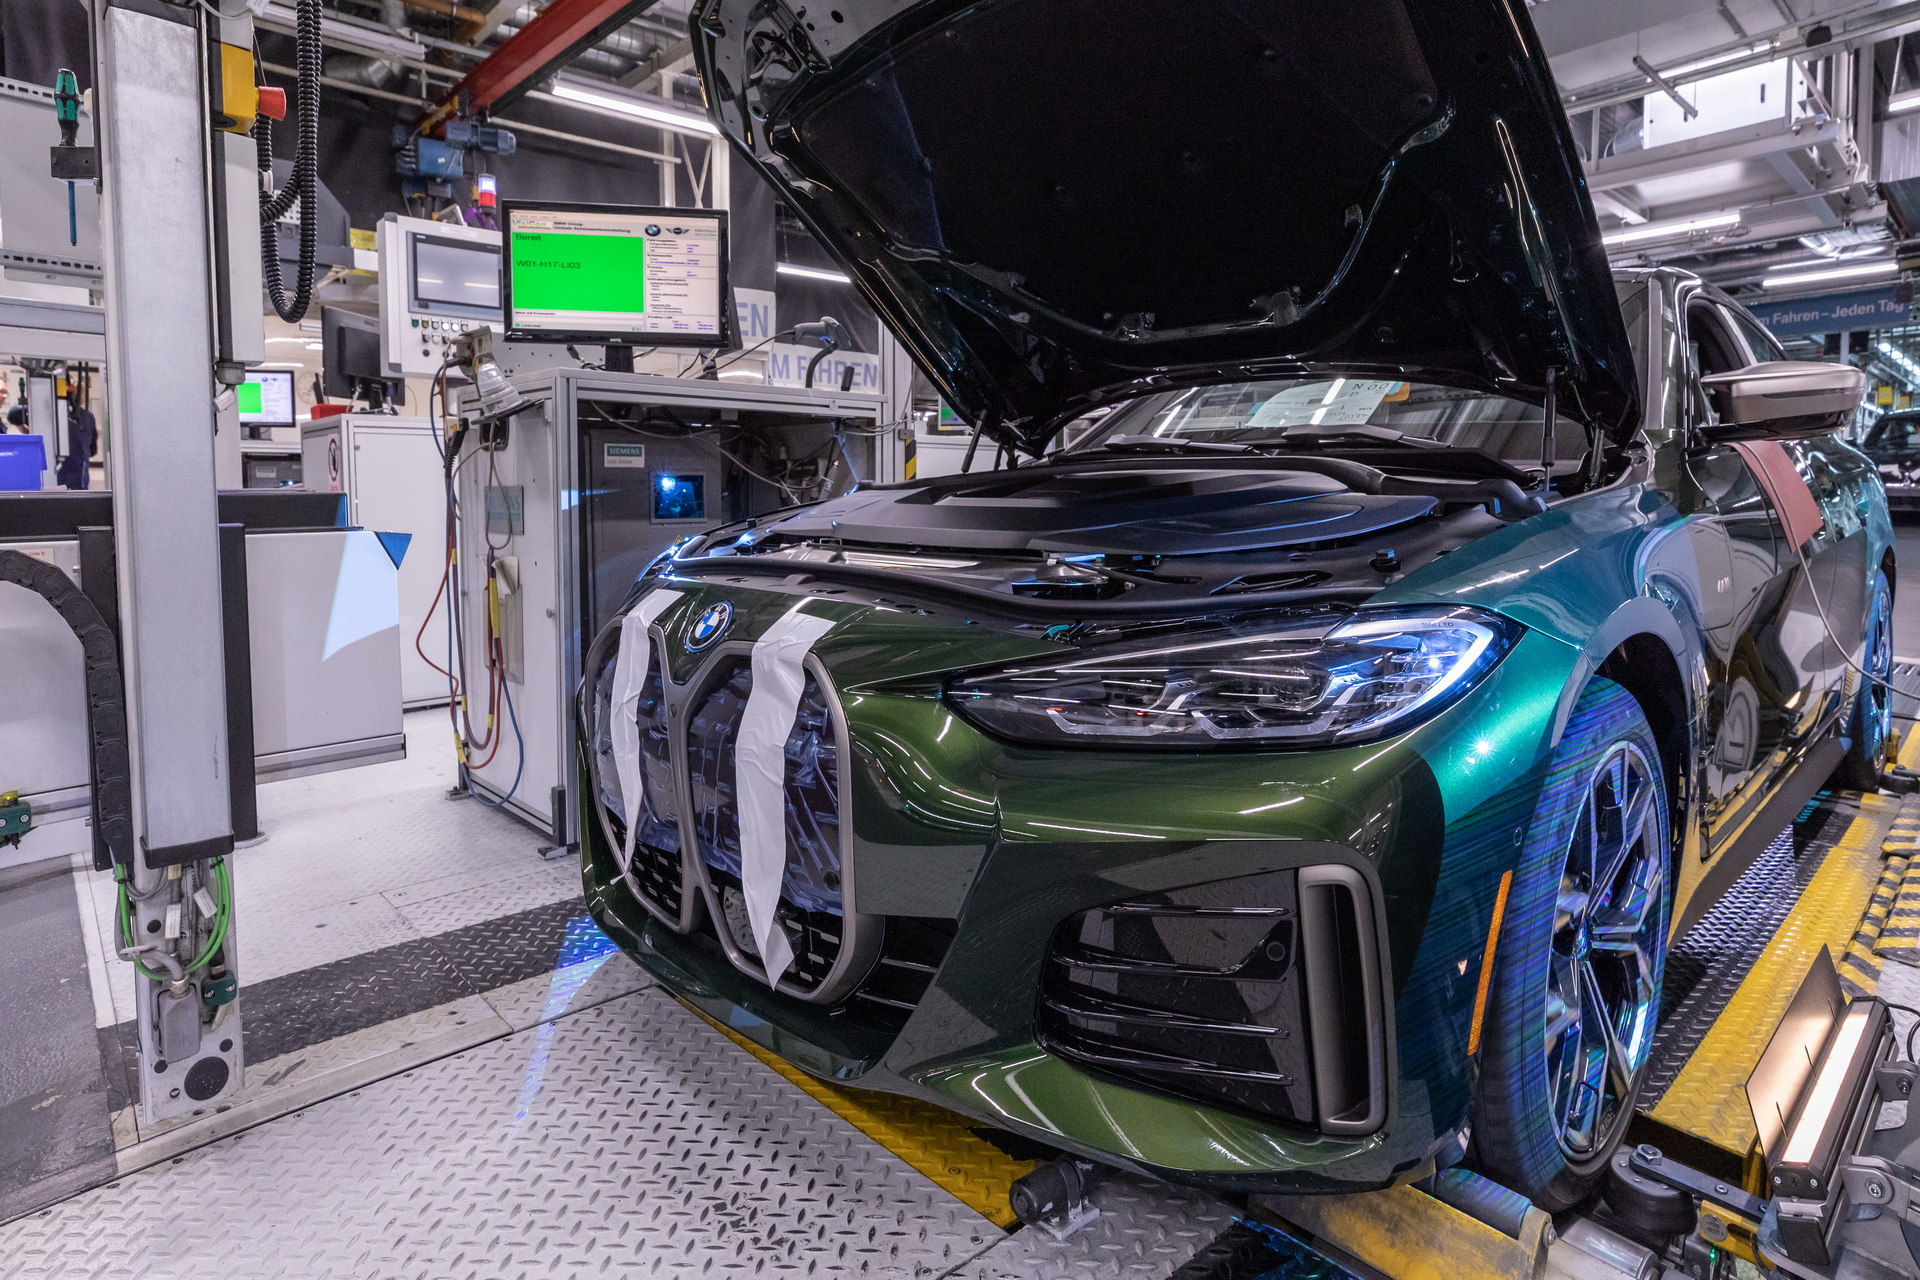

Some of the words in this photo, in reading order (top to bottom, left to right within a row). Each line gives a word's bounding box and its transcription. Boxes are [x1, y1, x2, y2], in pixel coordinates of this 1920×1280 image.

[515, 233, 542, 241] Bereit
[515, 260, 581, 269] W01-H17-LI03
[1772, 310, 1819, 325] Fahren
[1831, 303, 1875, 318] Jeden
[1877, 299, 1904, 313] Tag
[609, 447, 640, 455] SIEMENS
